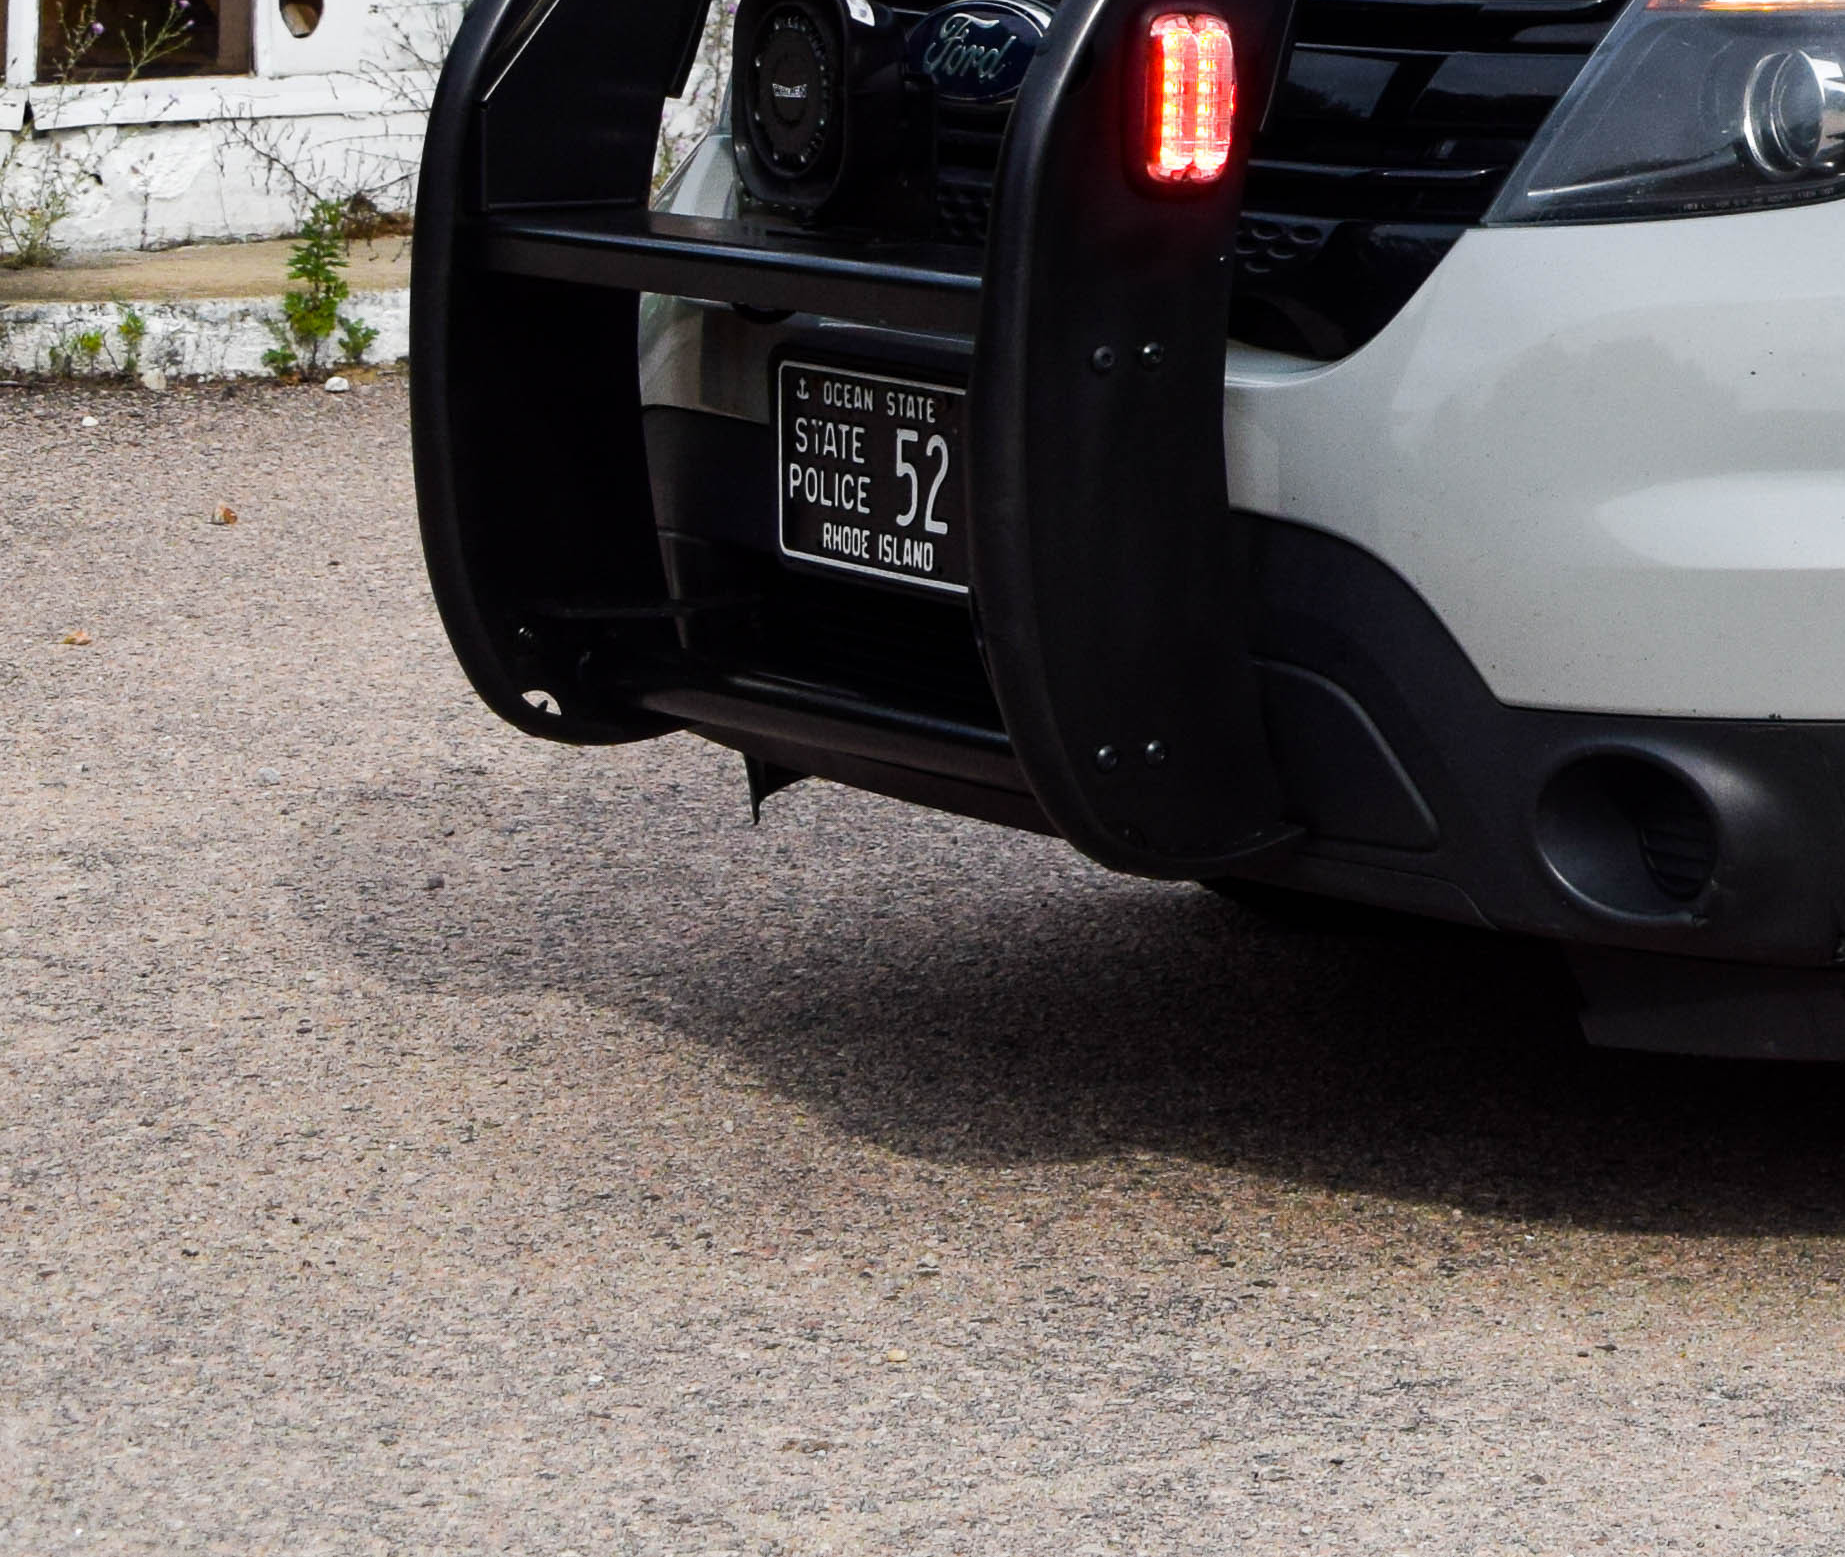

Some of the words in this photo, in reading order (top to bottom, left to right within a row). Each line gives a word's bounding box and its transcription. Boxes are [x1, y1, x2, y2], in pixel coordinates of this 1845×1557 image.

[924, 12, 1017, 81] Ford
[823, 381, 873, 411] OCEAN
[887, 392, 936, 423] STATE
[795, 417, 865, 464] STATE
[789, 463, 871, 514] POLICE
[896, 428, 949, 535] 52
[823, 522, 870, 559] RHODE
[878, 533, 934, 572] ISLAND
